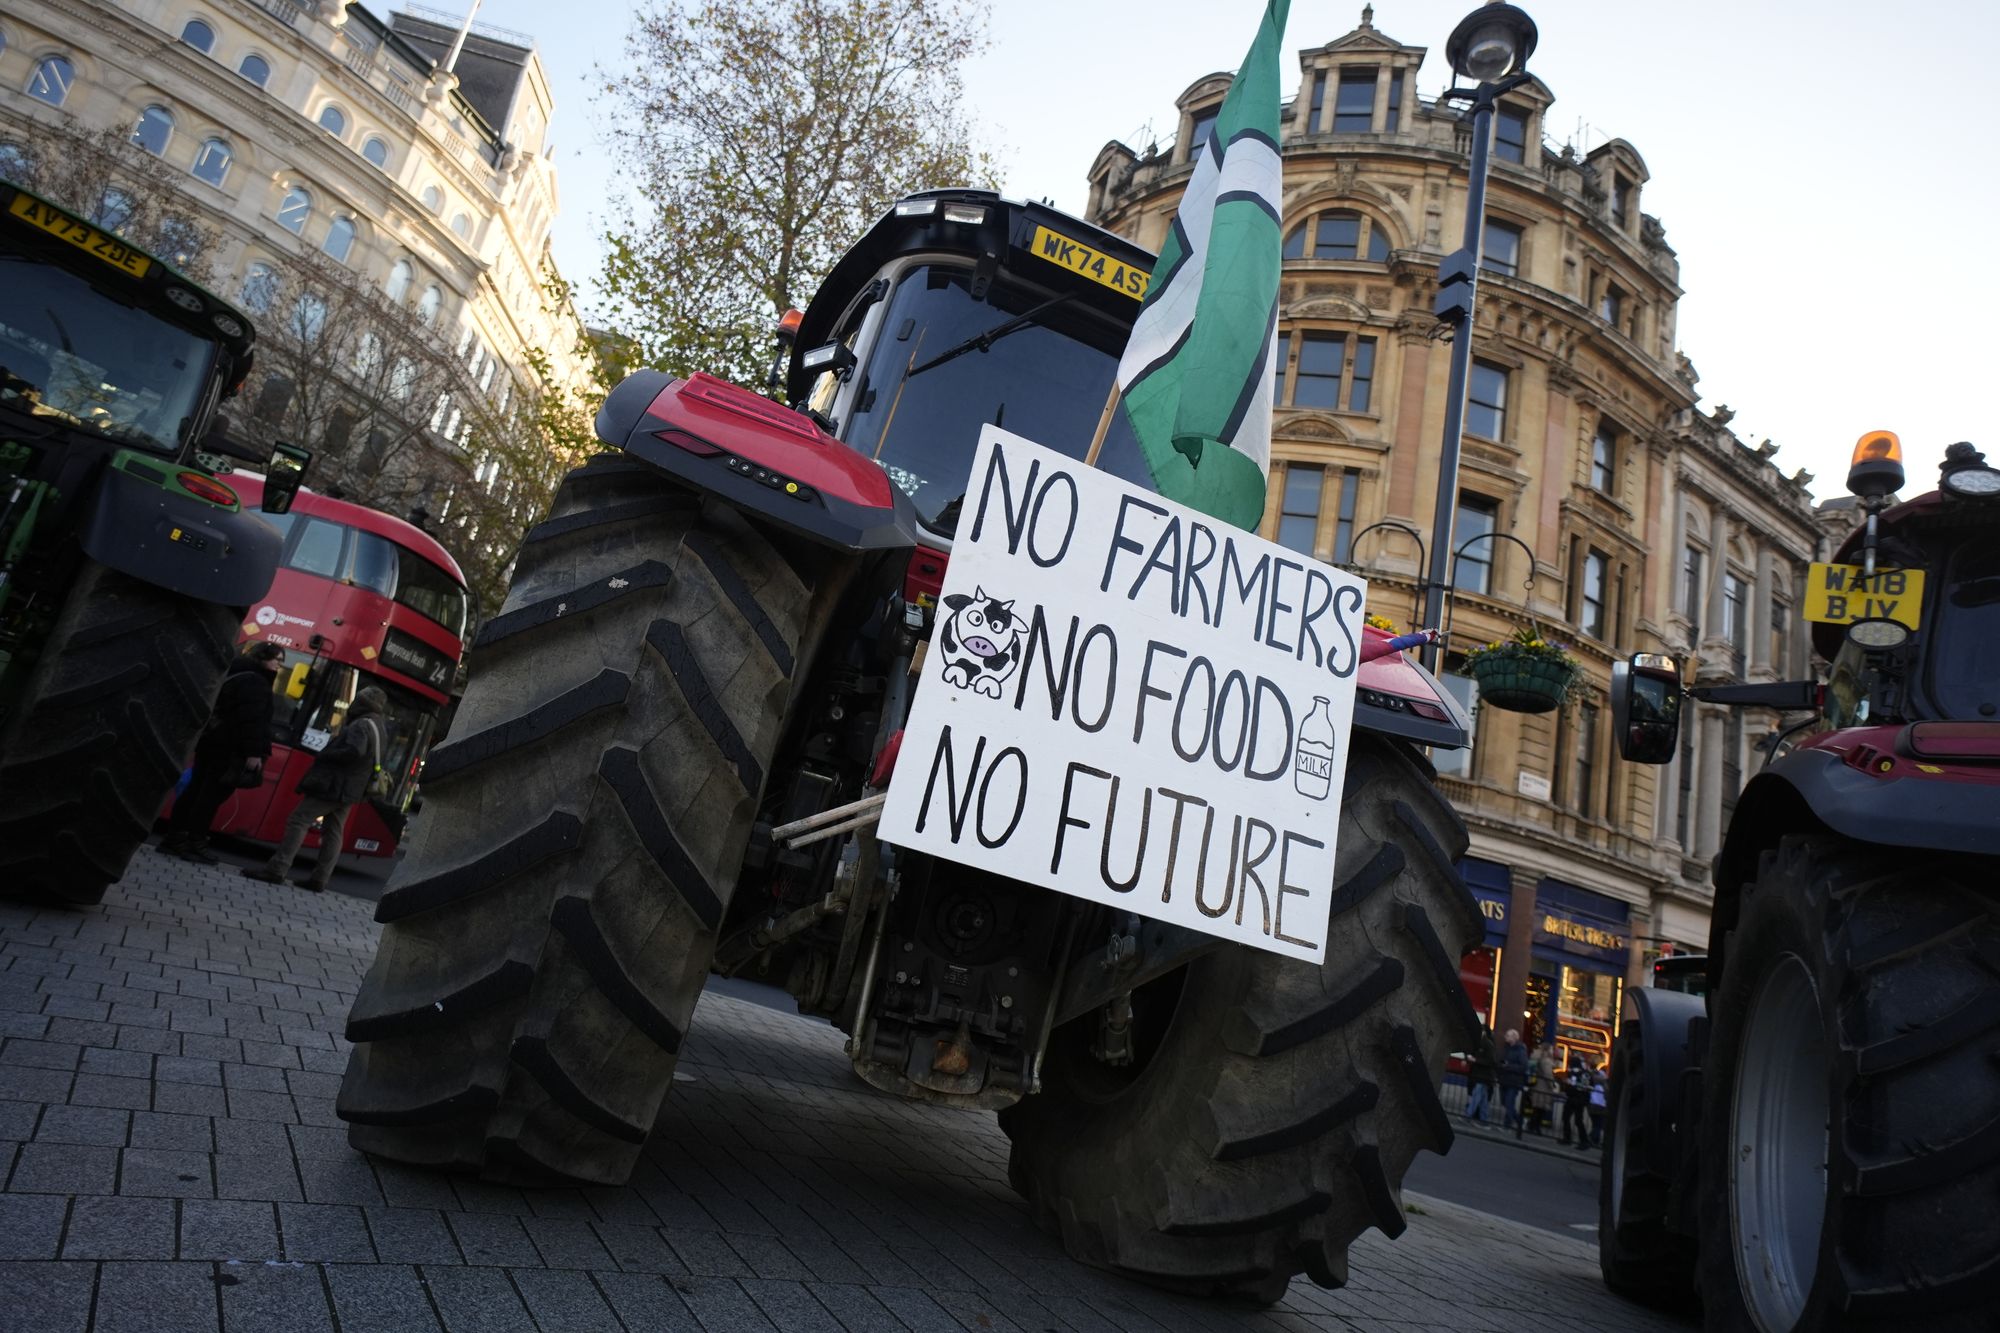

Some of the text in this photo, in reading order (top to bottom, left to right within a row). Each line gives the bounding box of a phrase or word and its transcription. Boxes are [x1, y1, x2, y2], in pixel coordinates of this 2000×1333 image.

[23, 201, 91, 244] AV73
[1043, 233, 1106, 278] WK74
[969, 443, 1363, 679] NO FARMERS
[1825, 566, 1907, 596] WA18
[429, 661, 447, 684] 24
[1014, 604, 1294, 782] NO FOOD
[1297, 754, 1329, 777] MILK
[915, 725, 1325, 950] NO FUTURE
